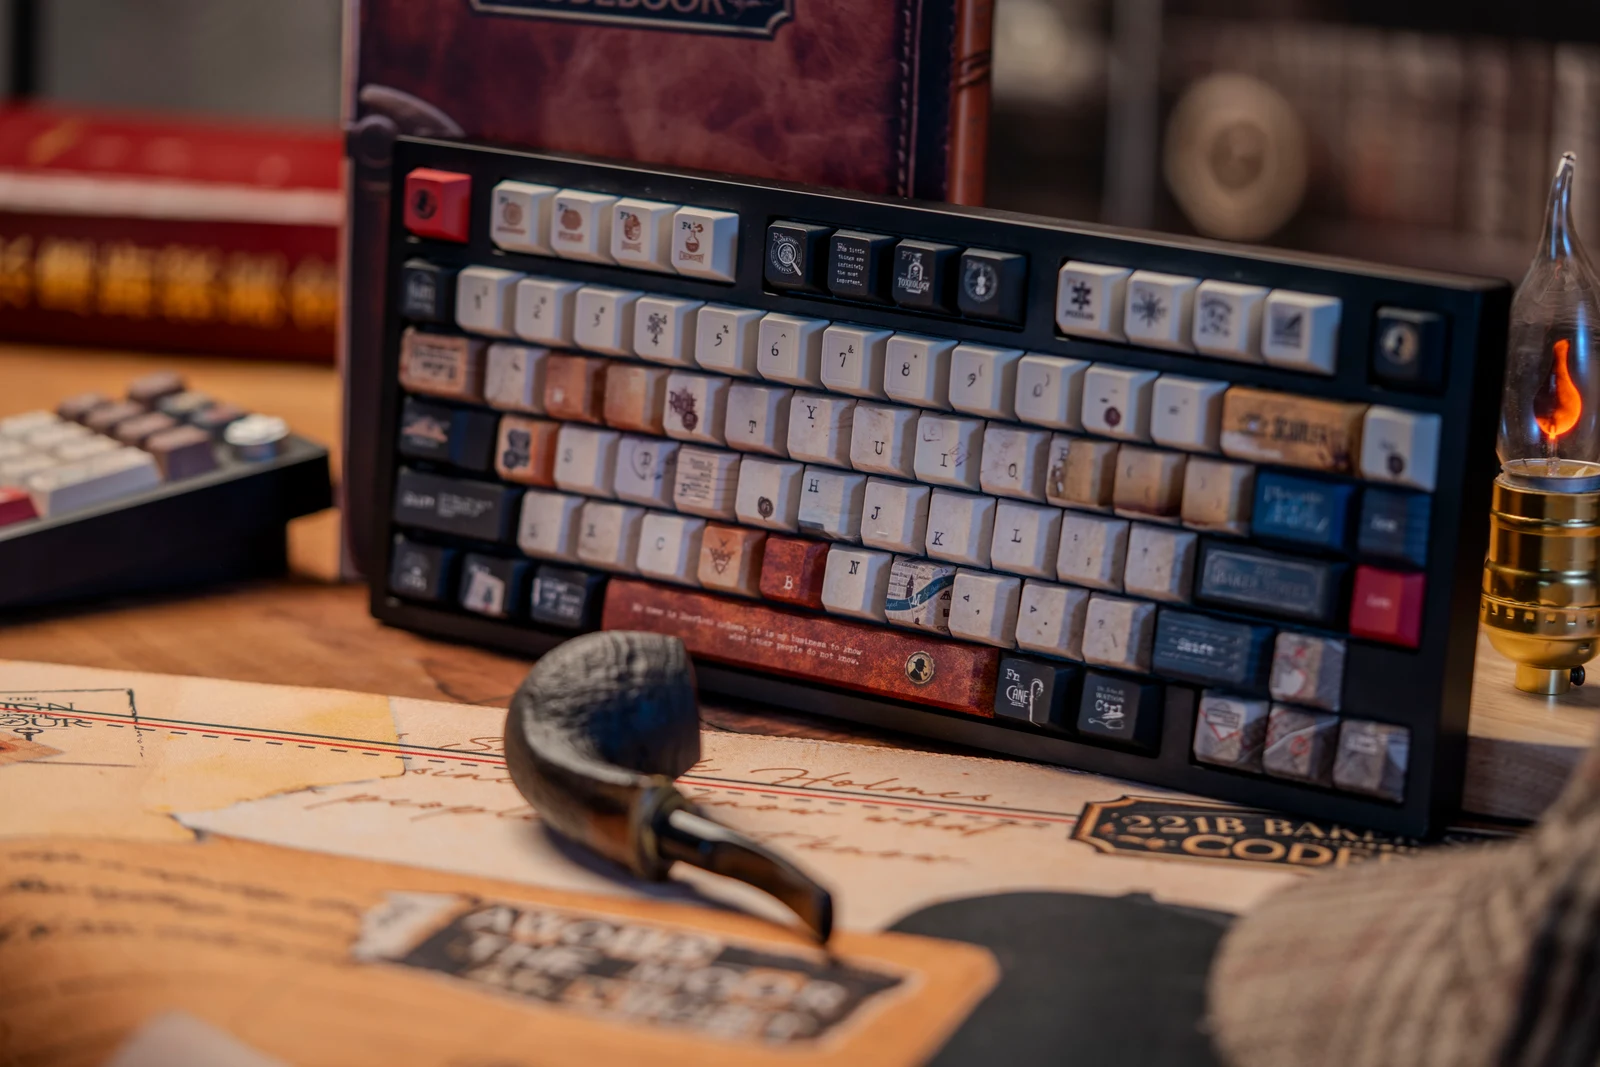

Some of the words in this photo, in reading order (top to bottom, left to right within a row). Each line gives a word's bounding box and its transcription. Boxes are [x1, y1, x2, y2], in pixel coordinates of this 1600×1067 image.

[682, 221, 691, 230] F4
[679, 250, 704, 263] CHEMISTRY
[838, 254, 855, 262] things
[849, 247, 865, 255] little
[837, 262, 864, 272] infinitely
[714, 333, 723, 347] 5
[771, 342, 779, 356] 6
[847, 345, 854, 354] &
[839, 352, 847, 368] 7
[901, 362, 910, 376] 8
[967, 373, 976, 388] 9
[806, 405, 818, 420] Y
[749, 420, 757, 434] T
[874, 440, 885, 455] U
[939, 453, 949, 468] I
[808, 478, 819, 493] H
[871, 506, 881, 520] J
[932, 531, 945, 546] K
[1011, 528, 1022, 543] L
[656, 536, 665, 551] C
[849, 560, 861, 575] N
[784, 575, 793, 590] B
[912, 593, 922, 606] M
[765, 630, 775, 638] is
[777, 633, 787, 642] my
[791, 634, 827, 649] business
[831, 643, 840, 651] to
[843, 645, 863, 656] know
[750, 638, 774, 648] other
[776, 643, 803, 654] people
[806, 647, 817, 656] do
[820, 651, 835, 660] not
[838, 654, 860, 665] know.
[1005, 668, 1020, 682] Fn
[1006, 685, 1029, 704] CANE
[1095, 700, 1123, 714] Ctrl
[0, 716, 93, 729] OUR
[1121, 814, 1247, 836] 221B
